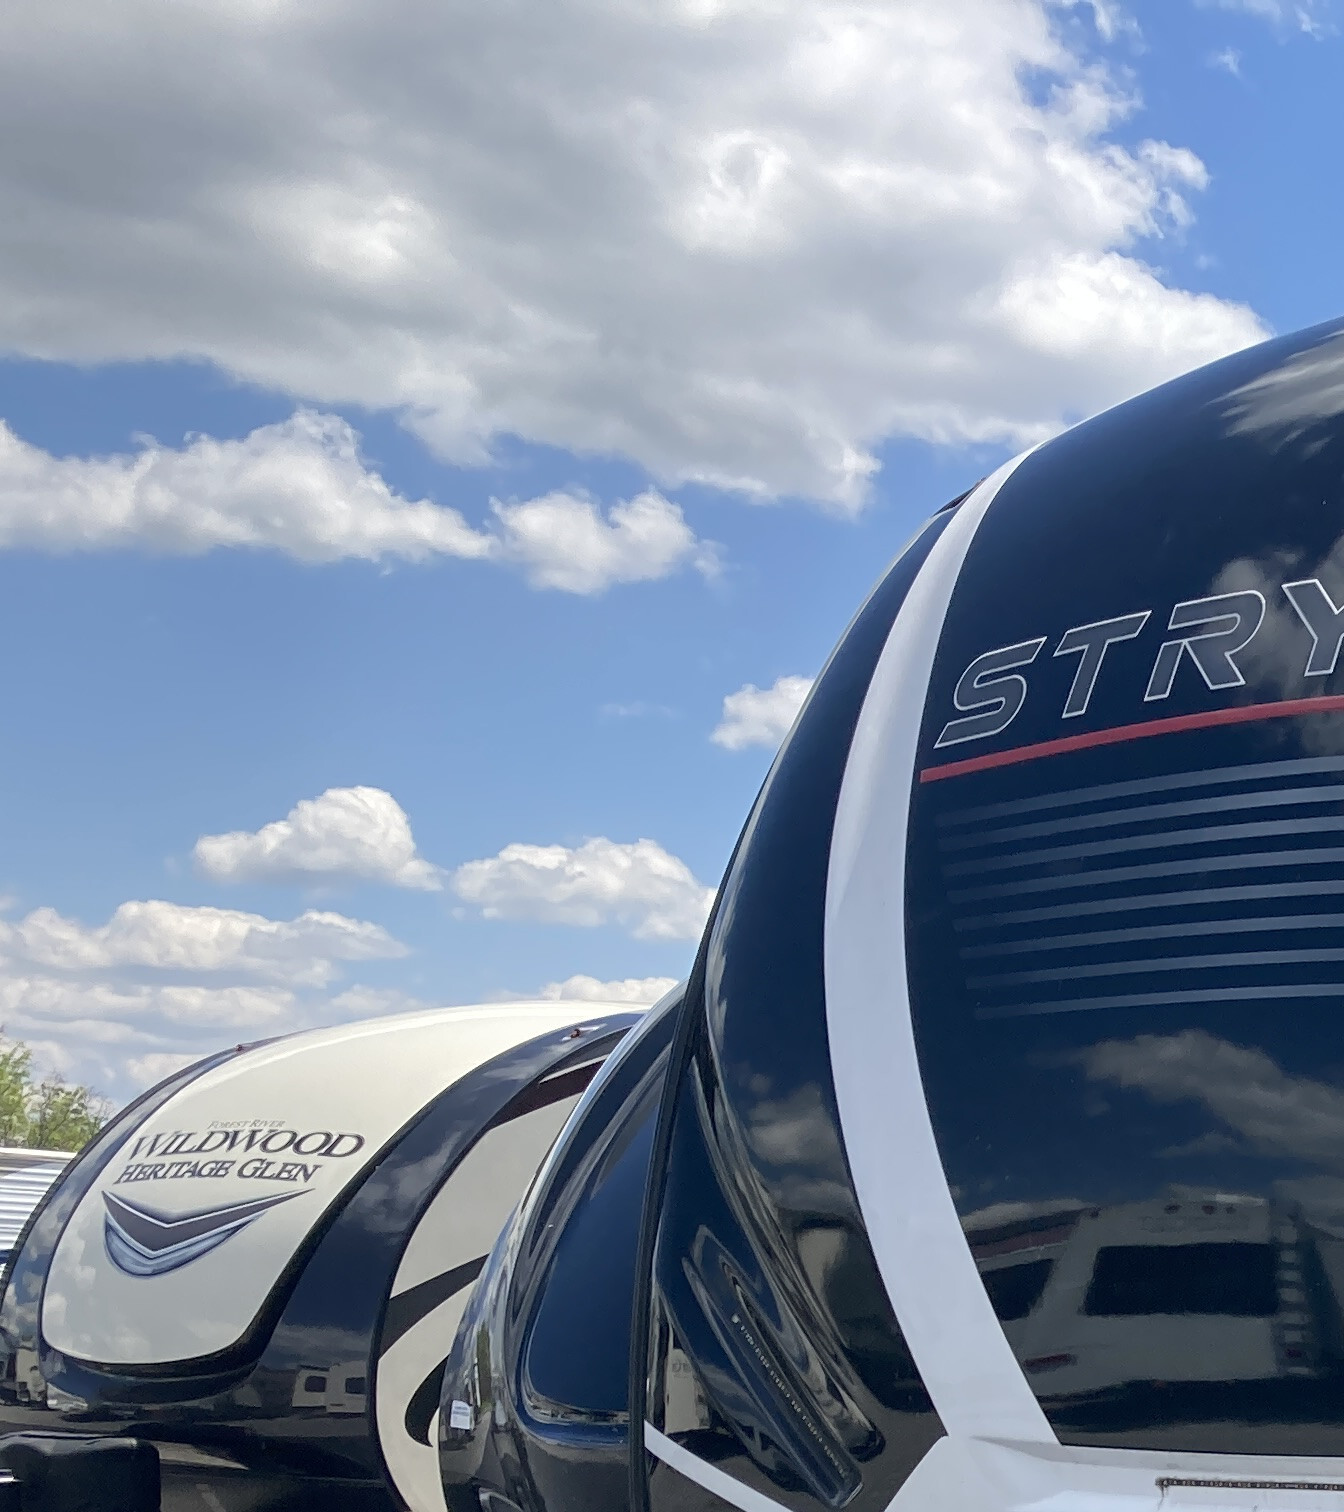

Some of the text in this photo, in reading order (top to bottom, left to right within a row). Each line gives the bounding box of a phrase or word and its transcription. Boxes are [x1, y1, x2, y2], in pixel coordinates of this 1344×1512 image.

[207, 1119, 286, 1129] FOREST RIVER
[128, 1129, 366, 1160] WILDWOOD
[113, 1158, 323, 1184] HERITAGE GLEN
